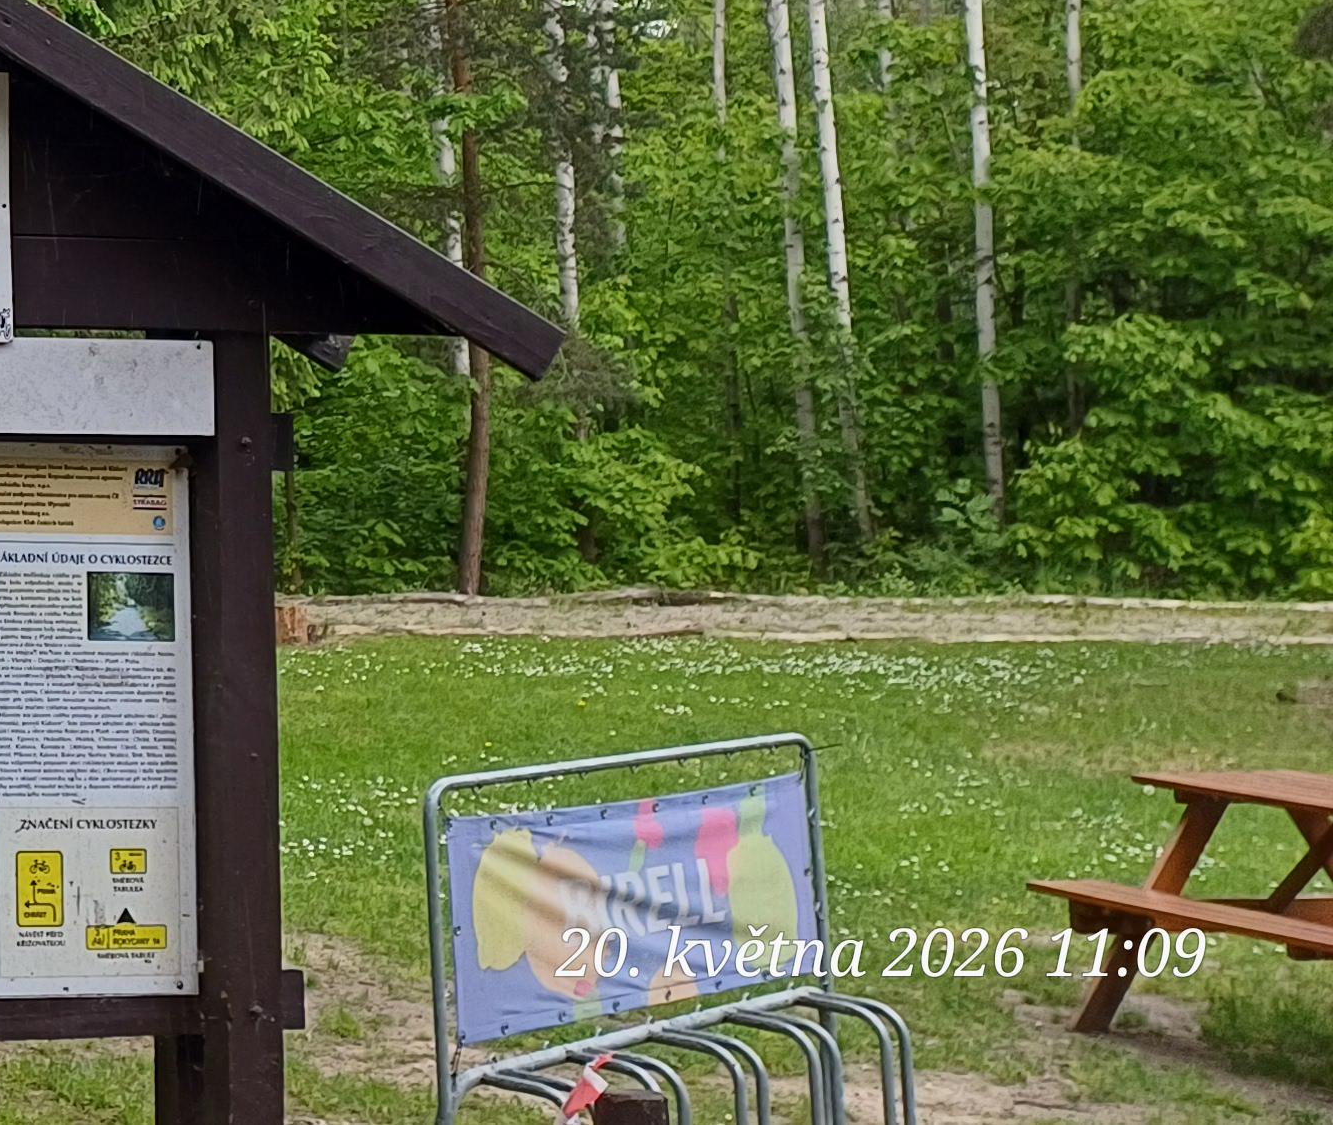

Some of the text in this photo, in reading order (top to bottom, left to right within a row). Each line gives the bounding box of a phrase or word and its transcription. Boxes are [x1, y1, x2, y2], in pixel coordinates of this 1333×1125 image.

[52, 552, 85, 565] ÚDAJE
[88, 554, 98, 564] O
[100, 554, 173, 565] CYKLOSTEZCE
[20, 818, 157, 829] ZNAČENÍ CYKLOSTEZKY
